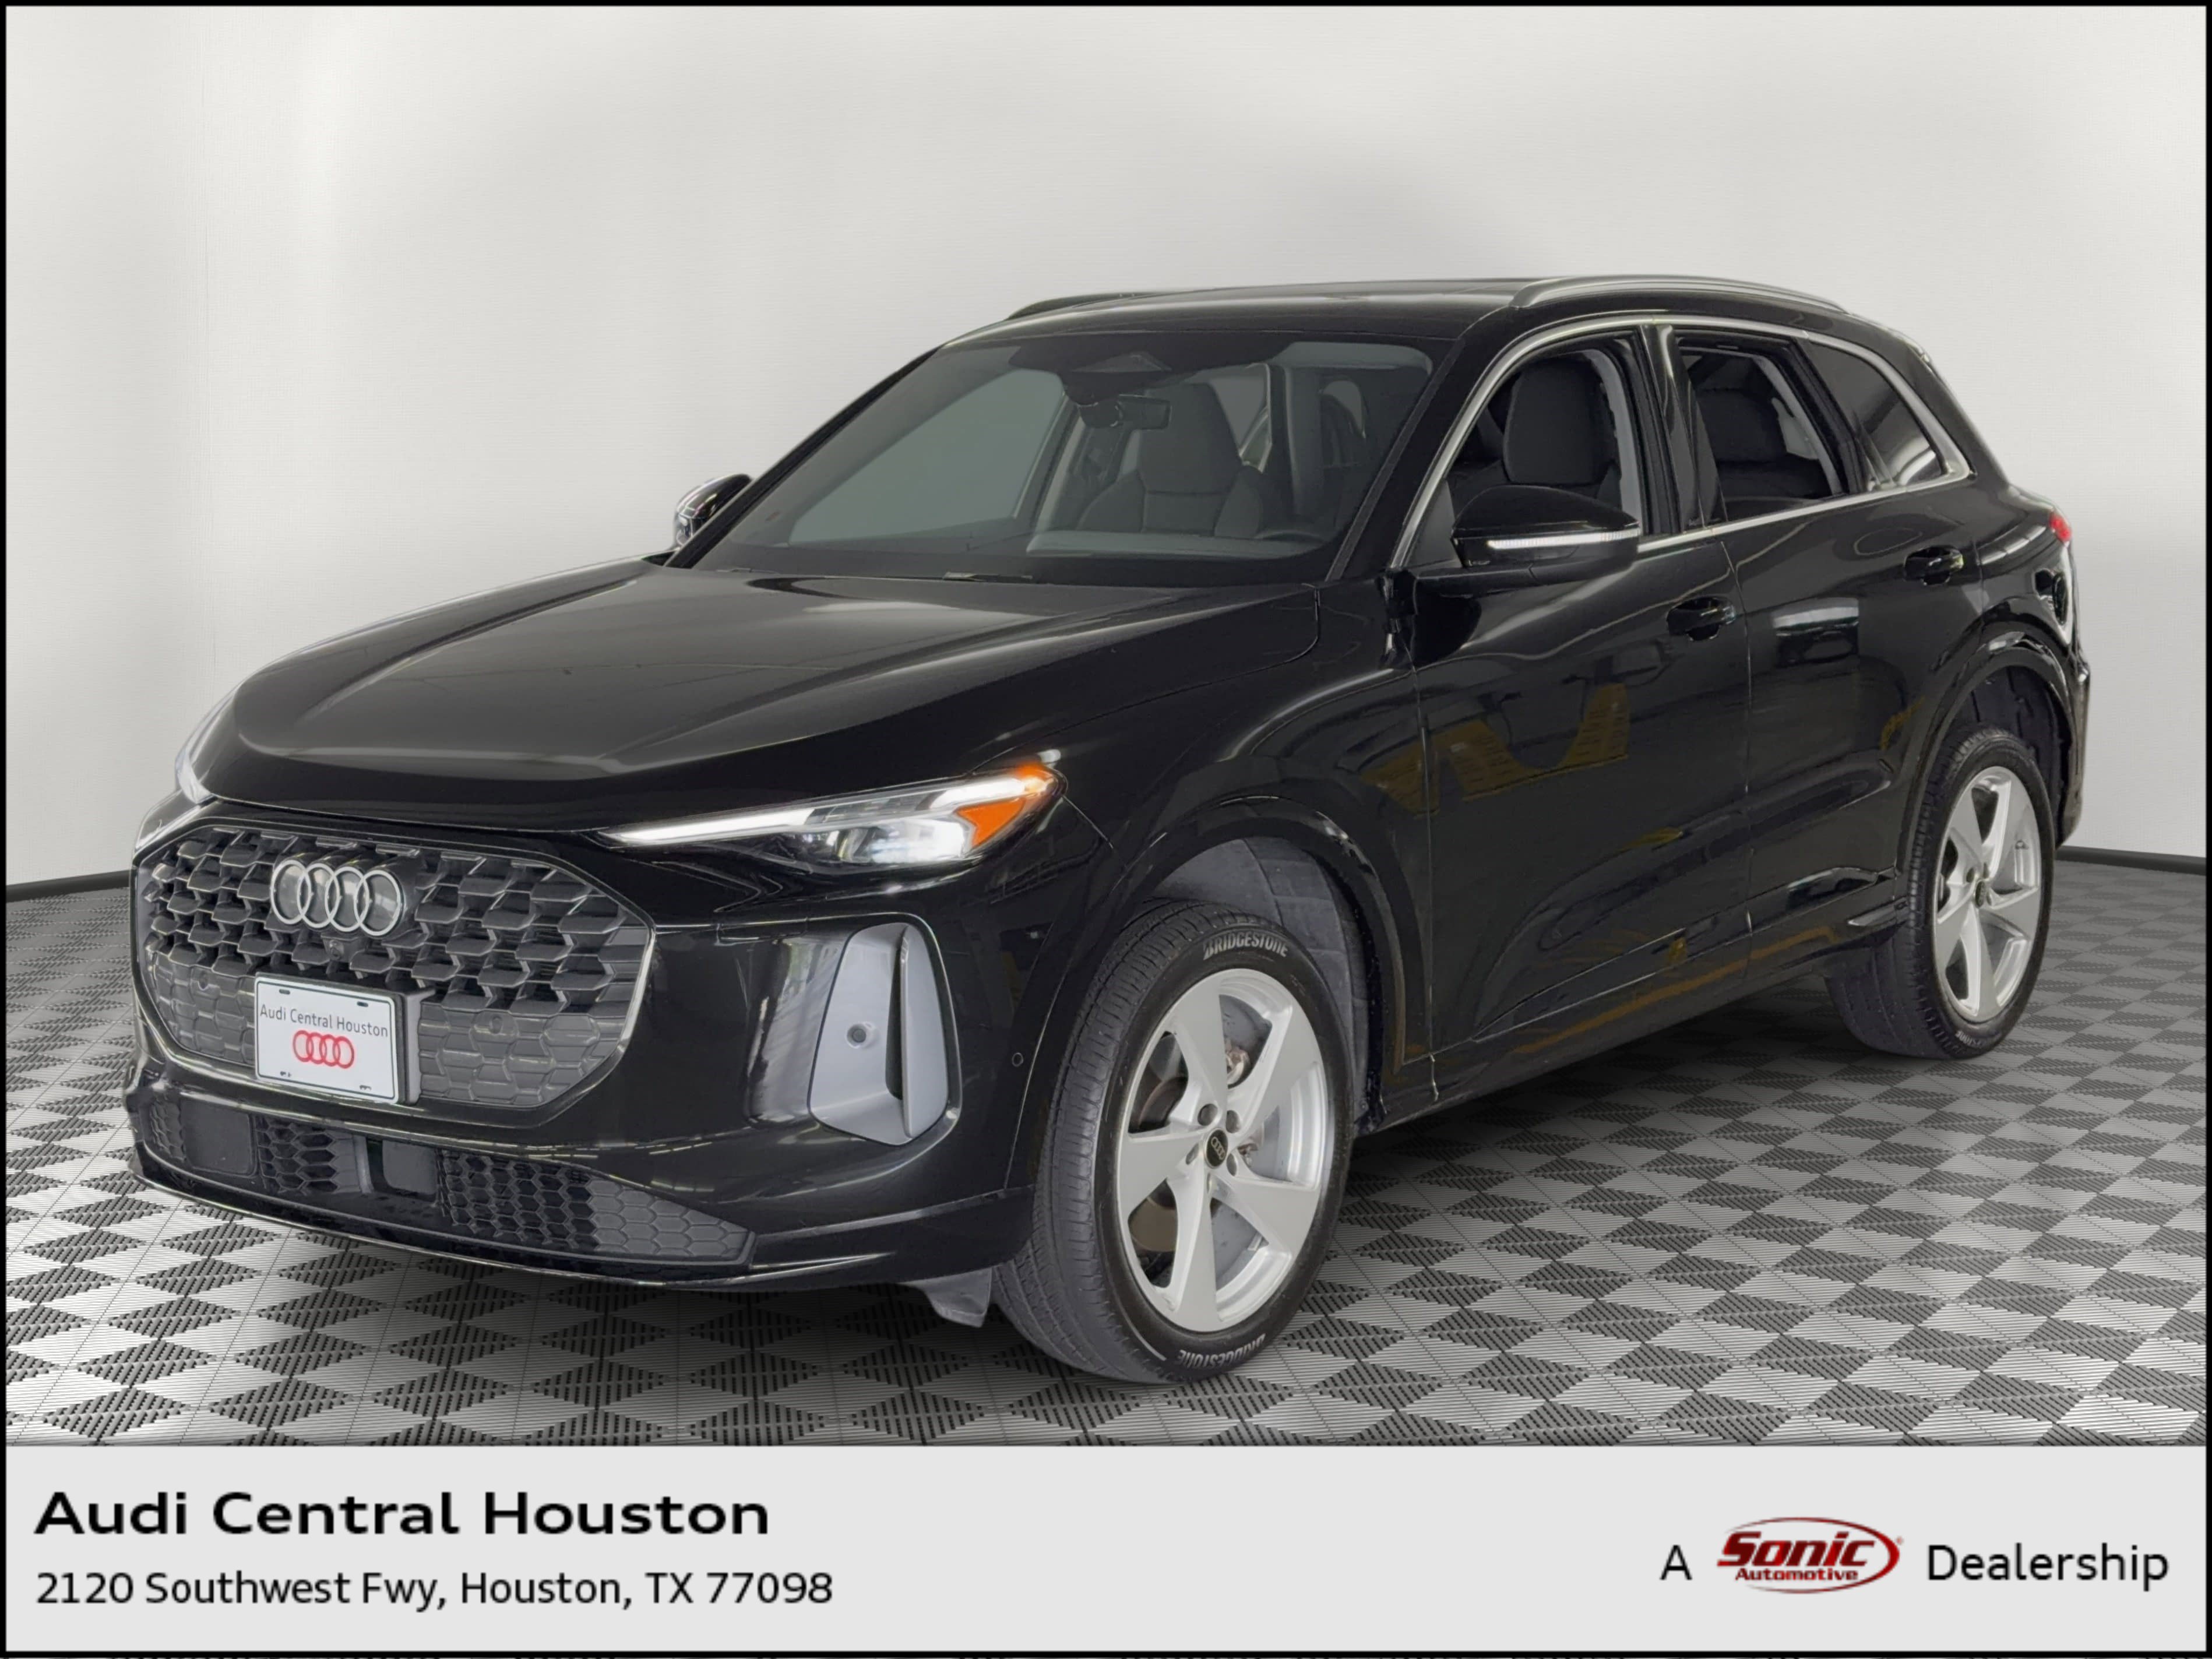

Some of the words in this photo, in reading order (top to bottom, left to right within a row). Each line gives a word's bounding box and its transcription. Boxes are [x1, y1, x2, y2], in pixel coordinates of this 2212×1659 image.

[1203, 932, 1288, 960] BRIDGESTONE
[260, 1004, 286, 1020] Audi
[290, 1009, 333, 1028] Central
[337, 1016, 388, 1037] Houston
